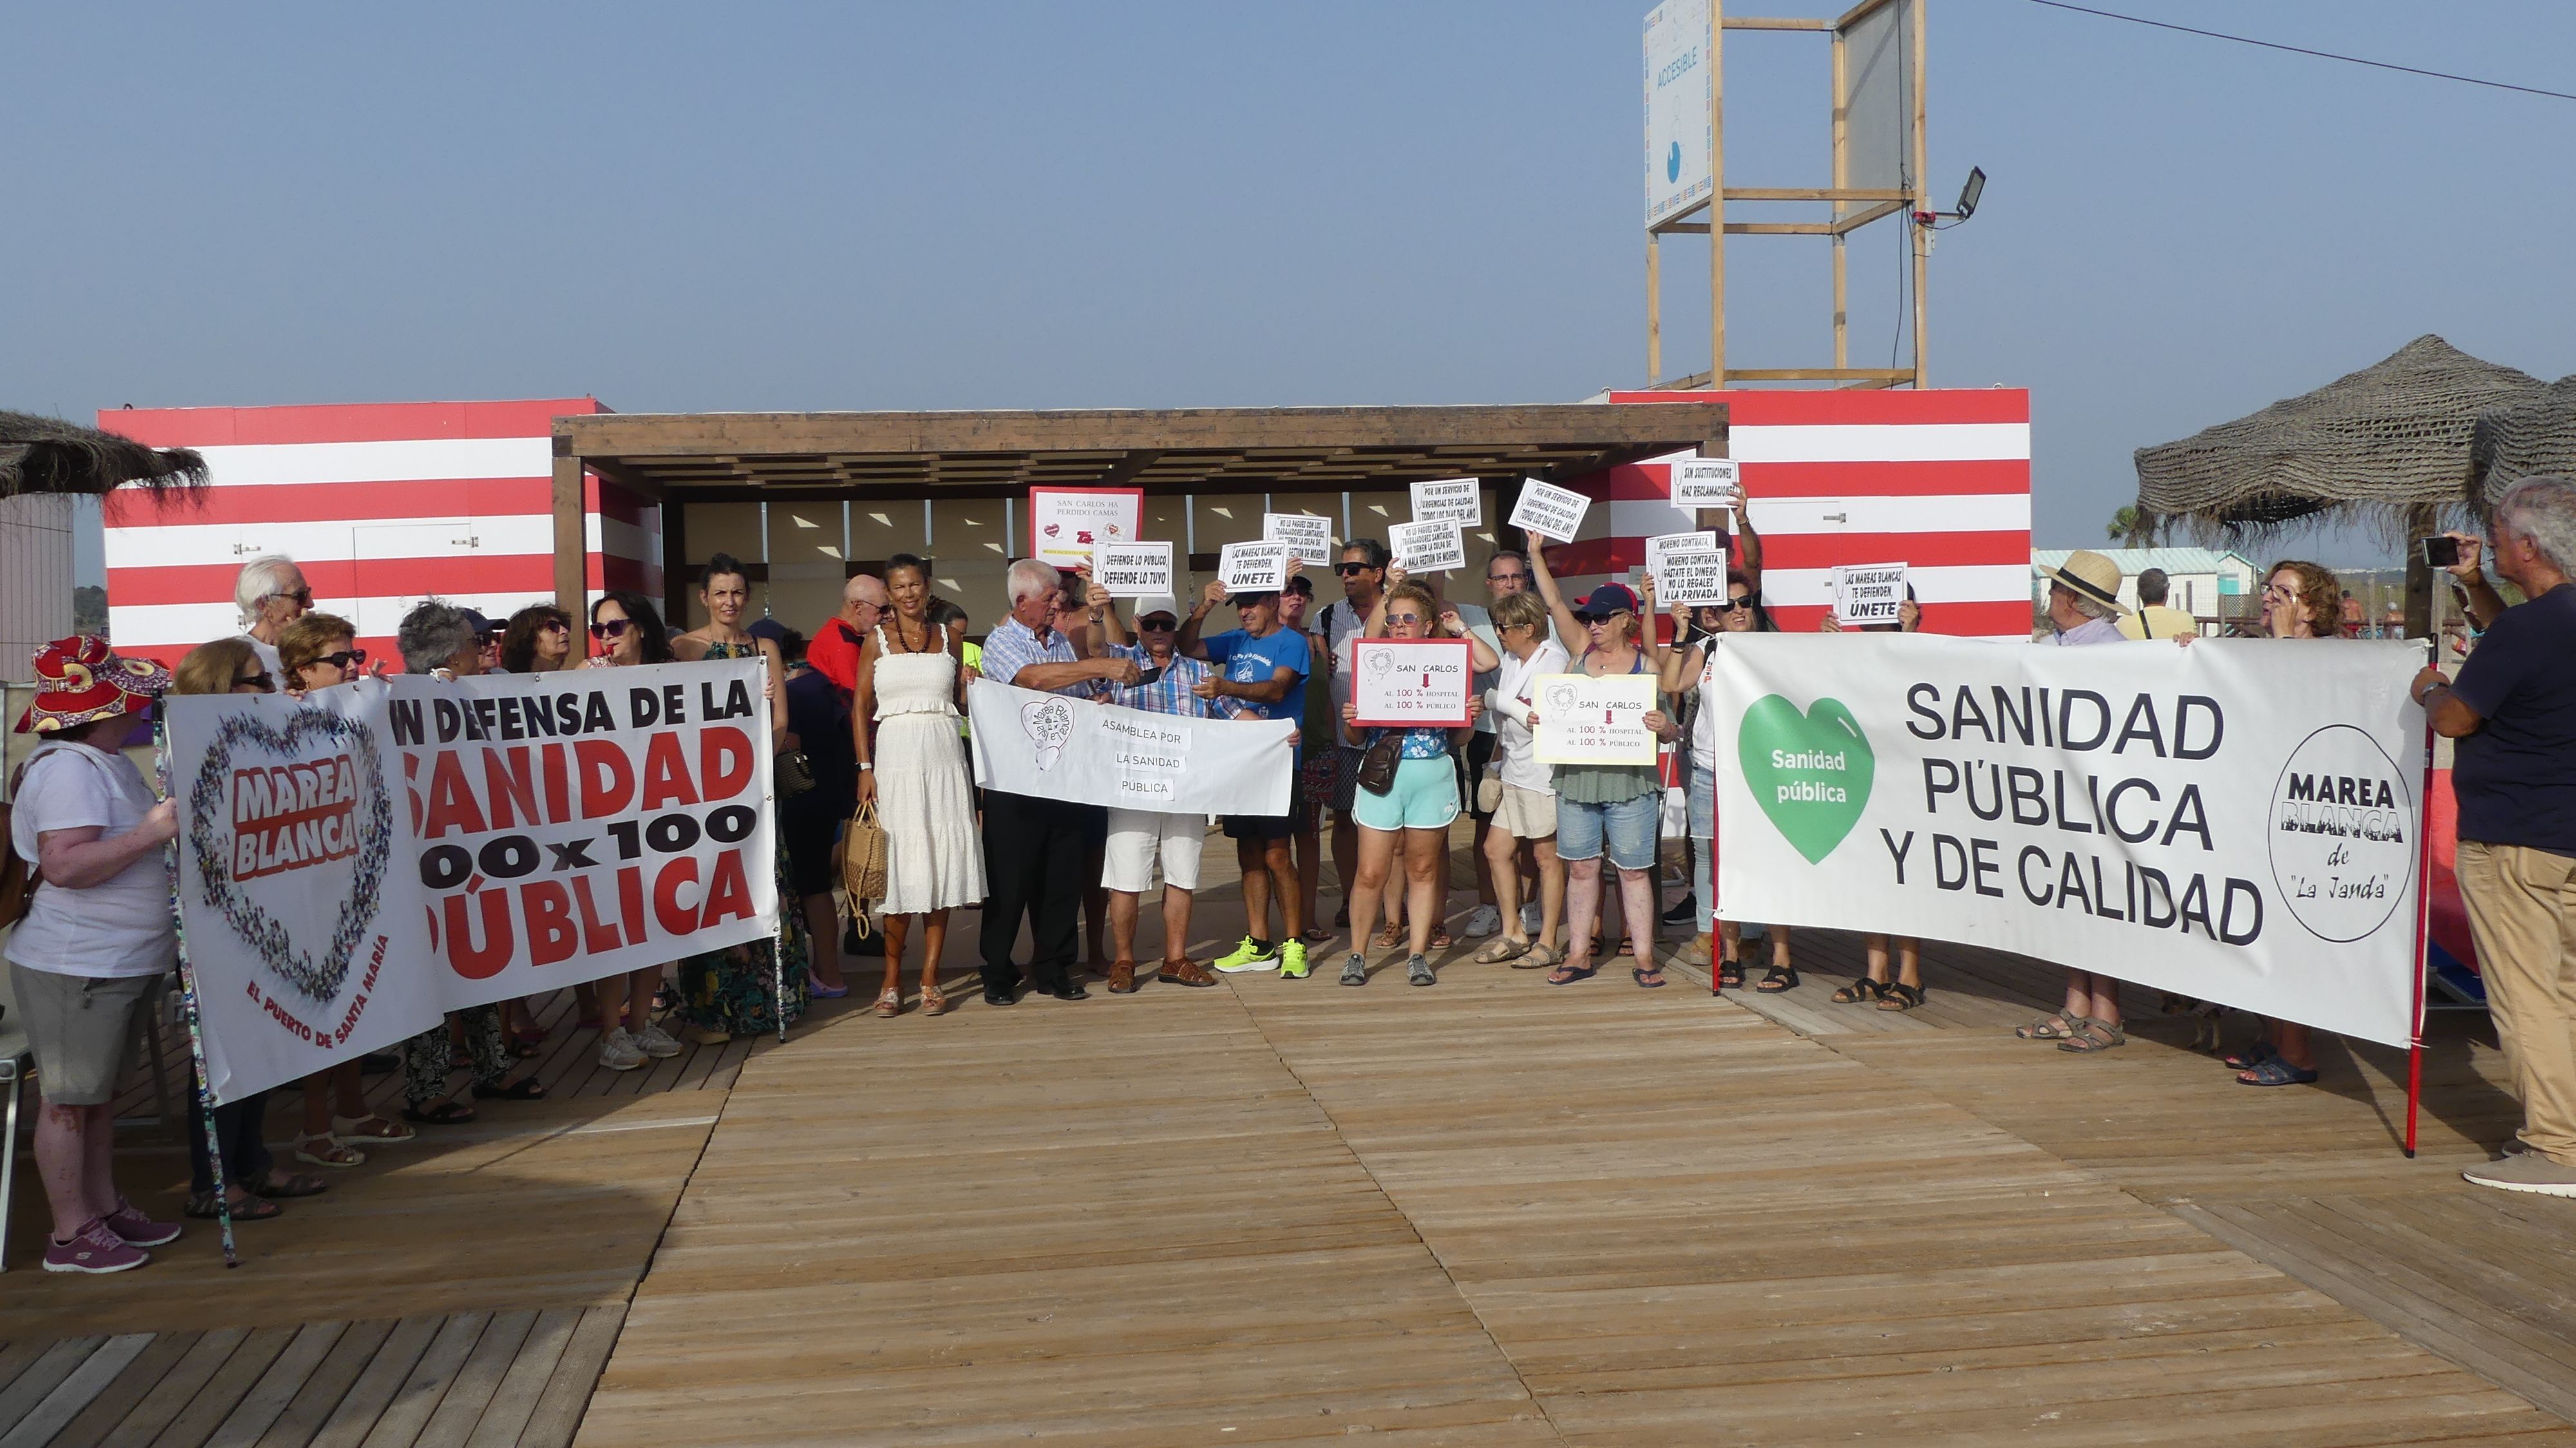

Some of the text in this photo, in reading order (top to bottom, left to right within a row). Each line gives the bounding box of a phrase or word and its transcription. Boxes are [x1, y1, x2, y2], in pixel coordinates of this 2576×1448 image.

[1658, 46, 1697, 90] ACCESIBLE
[1684, 467, 1732, 479] SIN SUSTITUCIONES
[1425, 487, 1434, 495] POR
[1442, 485, 1462, 494] SERVICIO
[1463, 484, 1470, 493] DE
[1681, 485, 1692, 497] HAZ
[1422, 496, 1473, 508] URGENCIAS DE CALIDAD
[1421, 511, 1435, 520] TODOS
[1457, 509, 1465, 520] DEL
[1466, 506, 1475, 519] AÑO
[1659, 539, 1680, 549] MORENO
[1232, 546, 1283, 558] LAS MAREAS BLANCAS
[1106, 552, 1168, 568] DEFIENDE LO PÚBLICO,
[1236, 558, 1273, 570] TE DEFIENDEN,
[1666, 555, 1719, 566] MORENO CONTRATA,
[1104, 571, 1166, 584] DEFIENDE LO TUYO
[1232, 571, 1275, 585] ÚNETE
[1663, 566, 1718, 578] GÁSTATE EL DINERO,
[1845, 571, 1902, 585] LAS MAREAS BLANCAS
[1668, 578, 1714, 589] NO LO REGALES
[1664, 589, 1718, 600] A LA PRIVADA
[1852, 586, 1893, 599] TE DEFIENDEN,
[1850, 600, 1896, 616] ÚNETE
[435, 691, 617, 743] DEFENSA
[630, 685, 686, 729] DE
[701, 679, 753, 722] LA
[1033, 705, 1070, 741] Marea Blanca La Isla
[1905, 682, 2224, 761] SANIDAD
[1102, 719, 1181, 744] ASAMBLEA POR
[1116, 754, 1180, 768] LA SANIDAD
[1772, 748, 1846, 771] Sanidad
[236, 757, 357, 827] MAREA
[1122, 779, 1168, 793] PÚBLICA
[1777, 780, 1847, 804] pública
[2287, 772, 2395, 809] MAREA
[1922, 757, 2215, 852] PÚBLICA
[2280, 801, 2404, 844] BLANCA
[235, 812, 359, 877] BLANCA
[2326, 842, 2351, 867] de
[1879, 828, 2264, 946] Y DE CALIDAD
[426, 848, 757, 980] ÚBLICA
[247, 934, 389, 1049] EL PUERTO DE SANTA MARÍA
